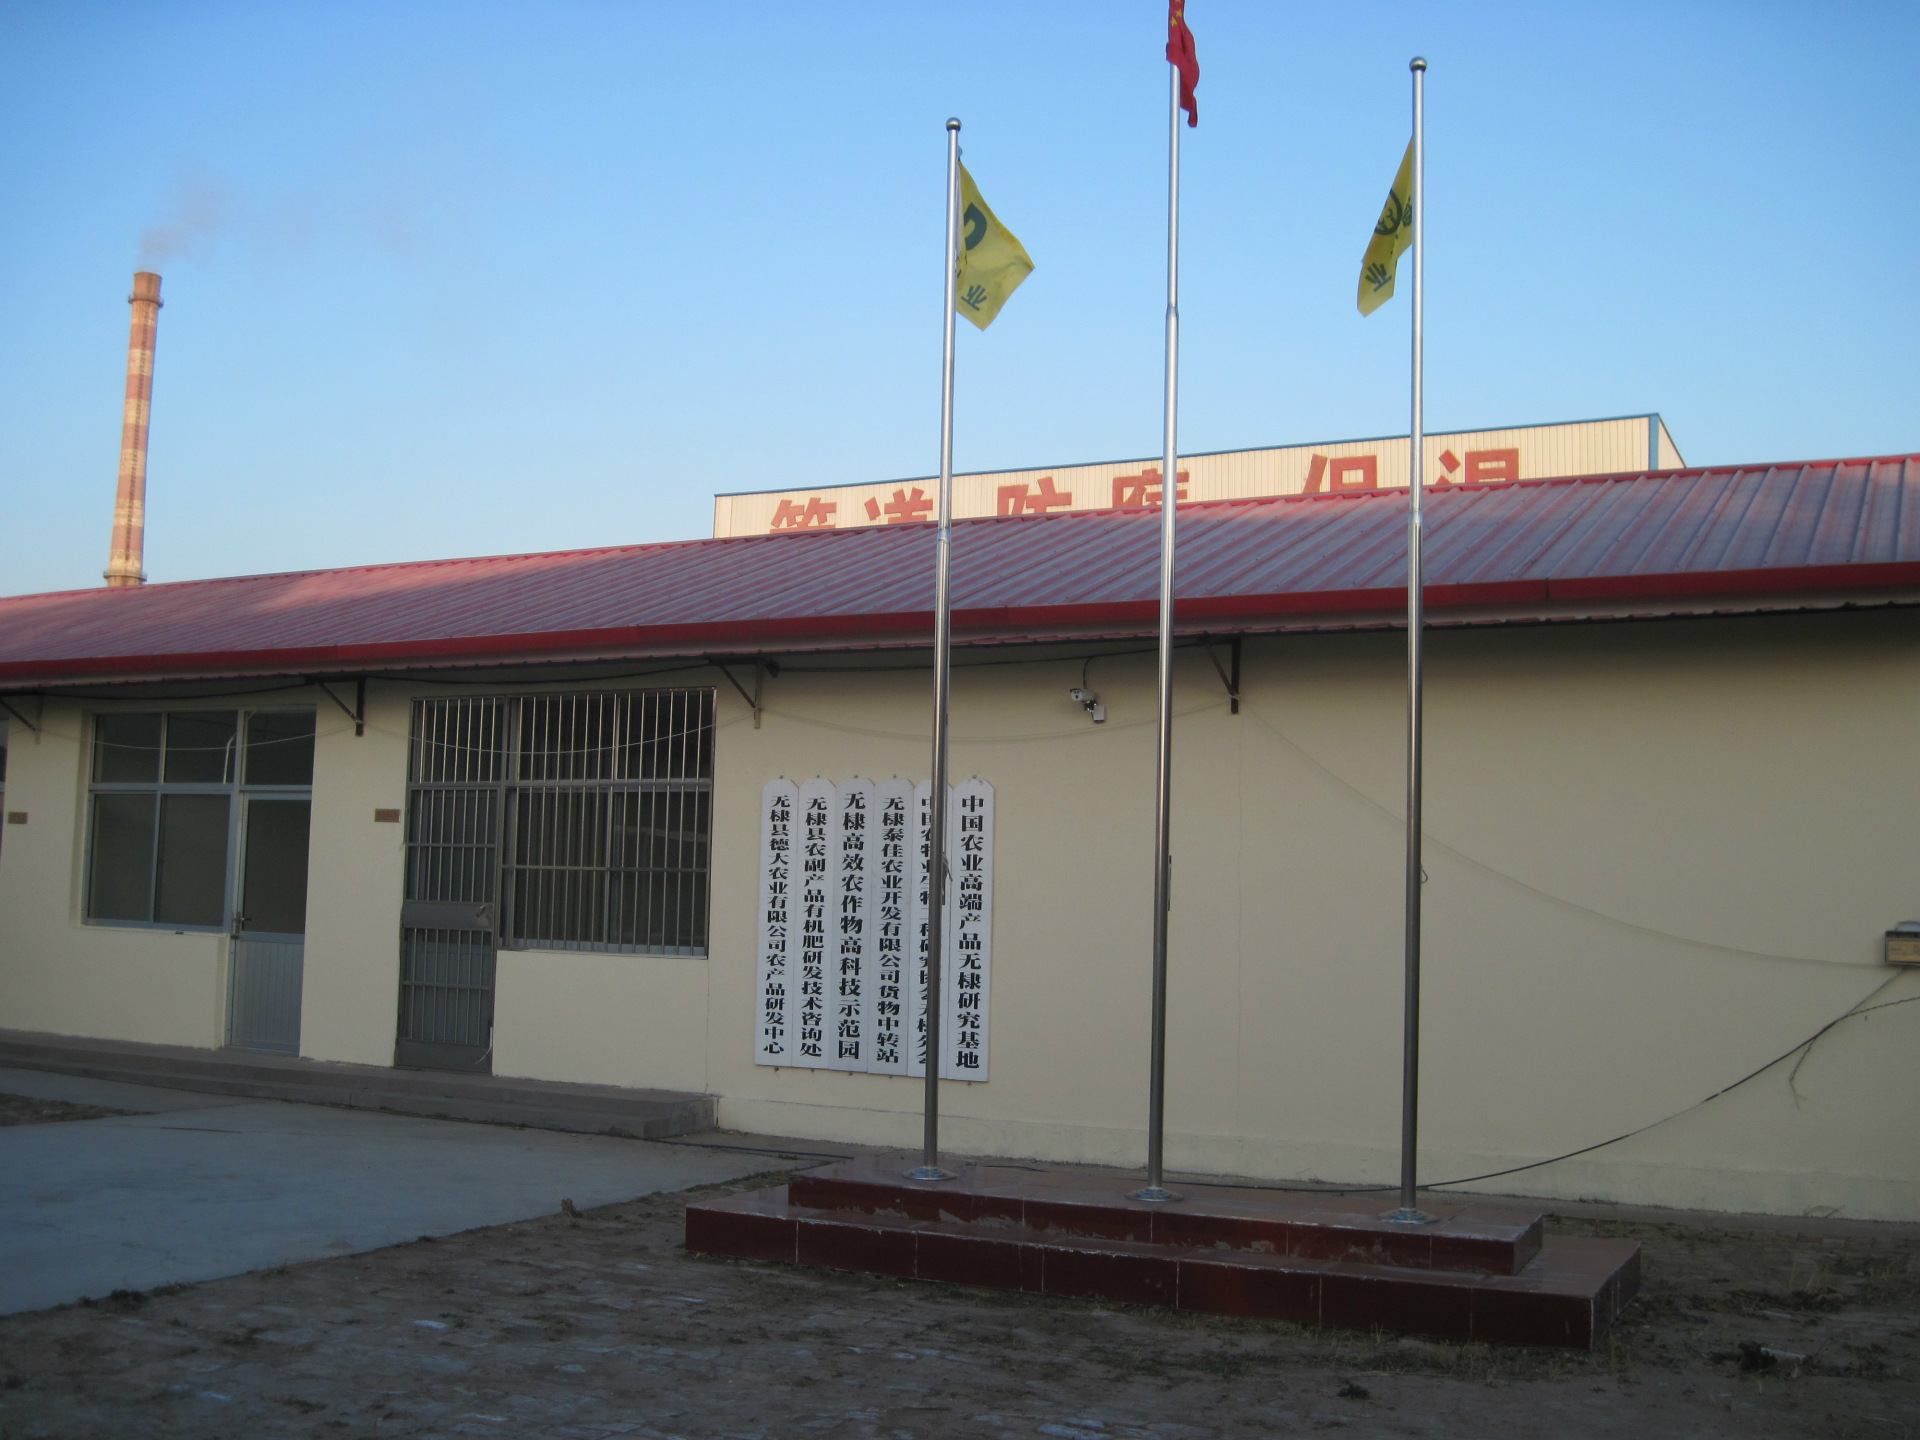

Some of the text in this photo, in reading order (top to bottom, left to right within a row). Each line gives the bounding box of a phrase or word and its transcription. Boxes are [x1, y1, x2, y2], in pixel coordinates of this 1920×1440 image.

[763, 795, 791, 1054] 无棣县德大农业有限公司农产品研发中心
[800, 797, 828, 1058] 无棣县农副产品有机肥研发技术咨询处
[837, 792, 866, 1060] 无棣高效农作物高科技示范园
[876, 797, 905, 1064] 无棣泰佳农业开发有限公司货物中转站
[955, 795, 984, 1069] 中国农业高端产品无棣研究基地
